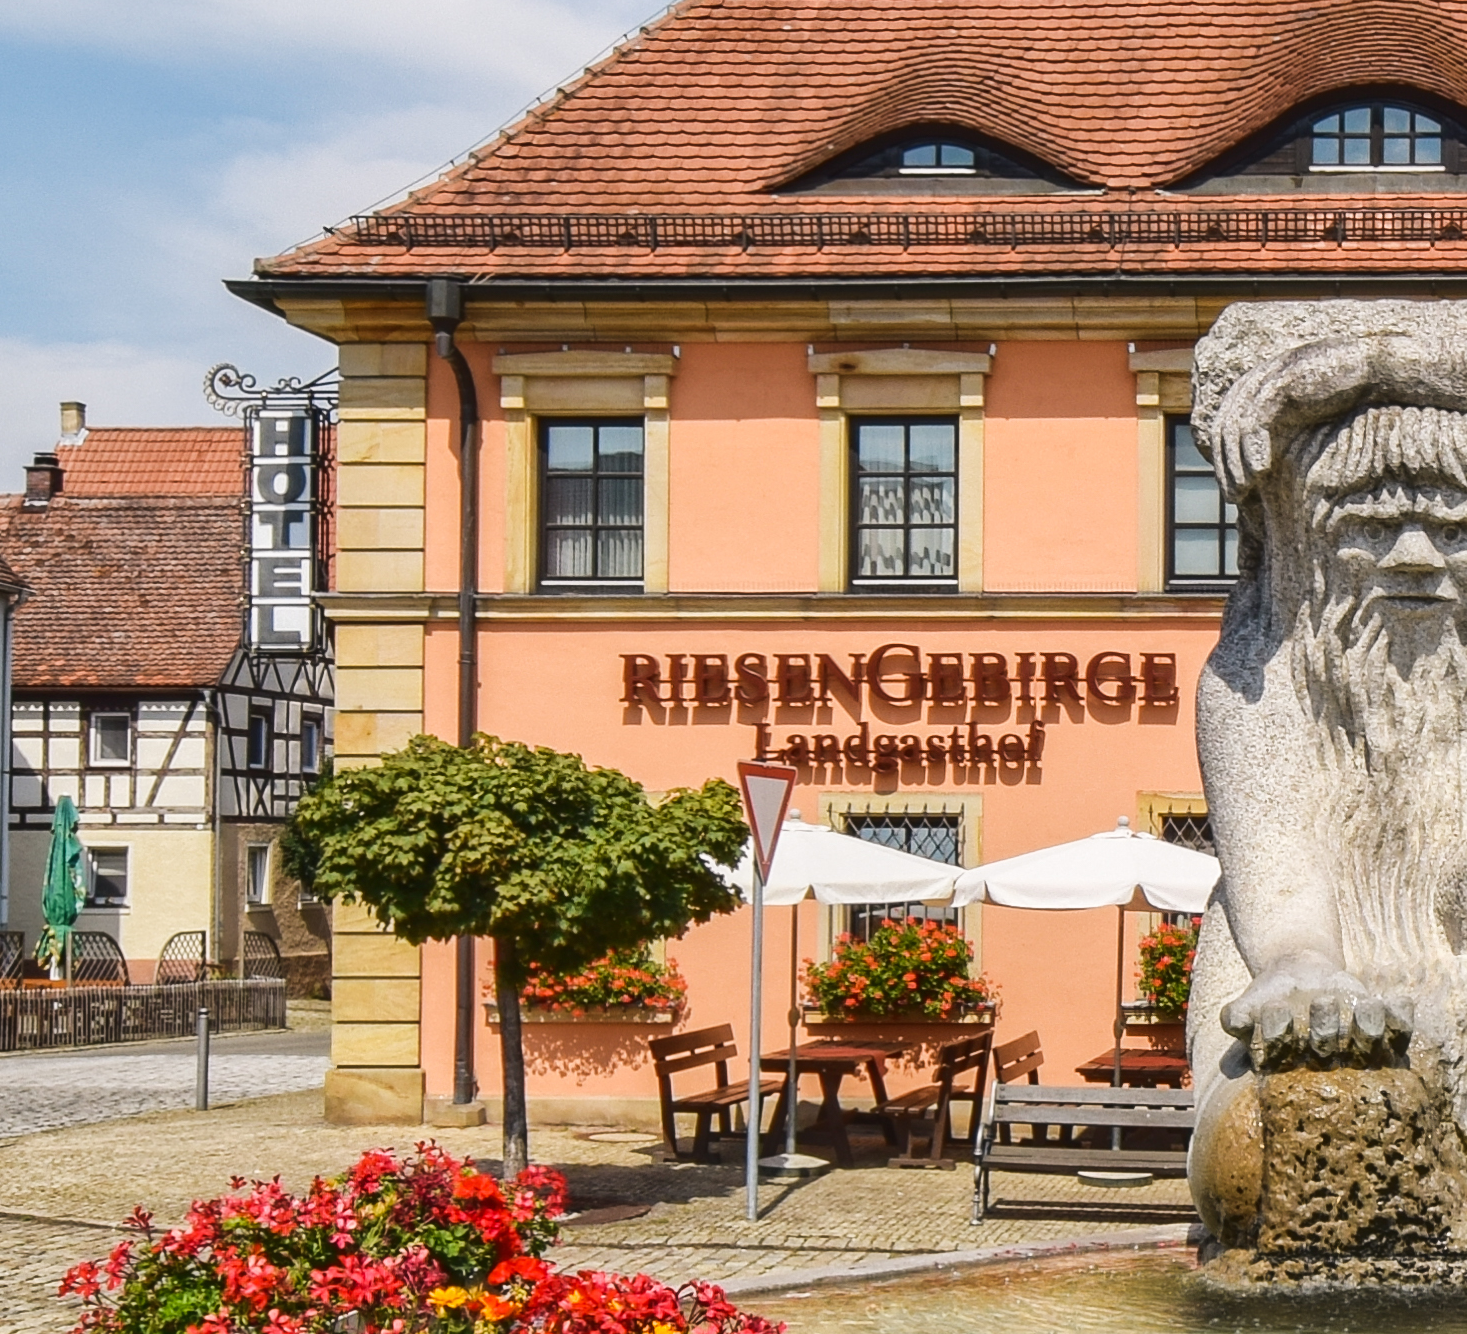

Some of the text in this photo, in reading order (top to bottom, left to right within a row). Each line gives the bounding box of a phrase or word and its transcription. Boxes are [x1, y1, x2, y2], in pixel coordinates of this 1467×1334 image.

[257, 417, 307, 645] HOTEL
[618, 643, 1180, 704] RIESENGEBIRGE
[750, 719, 1047, 773] Landgasthof
